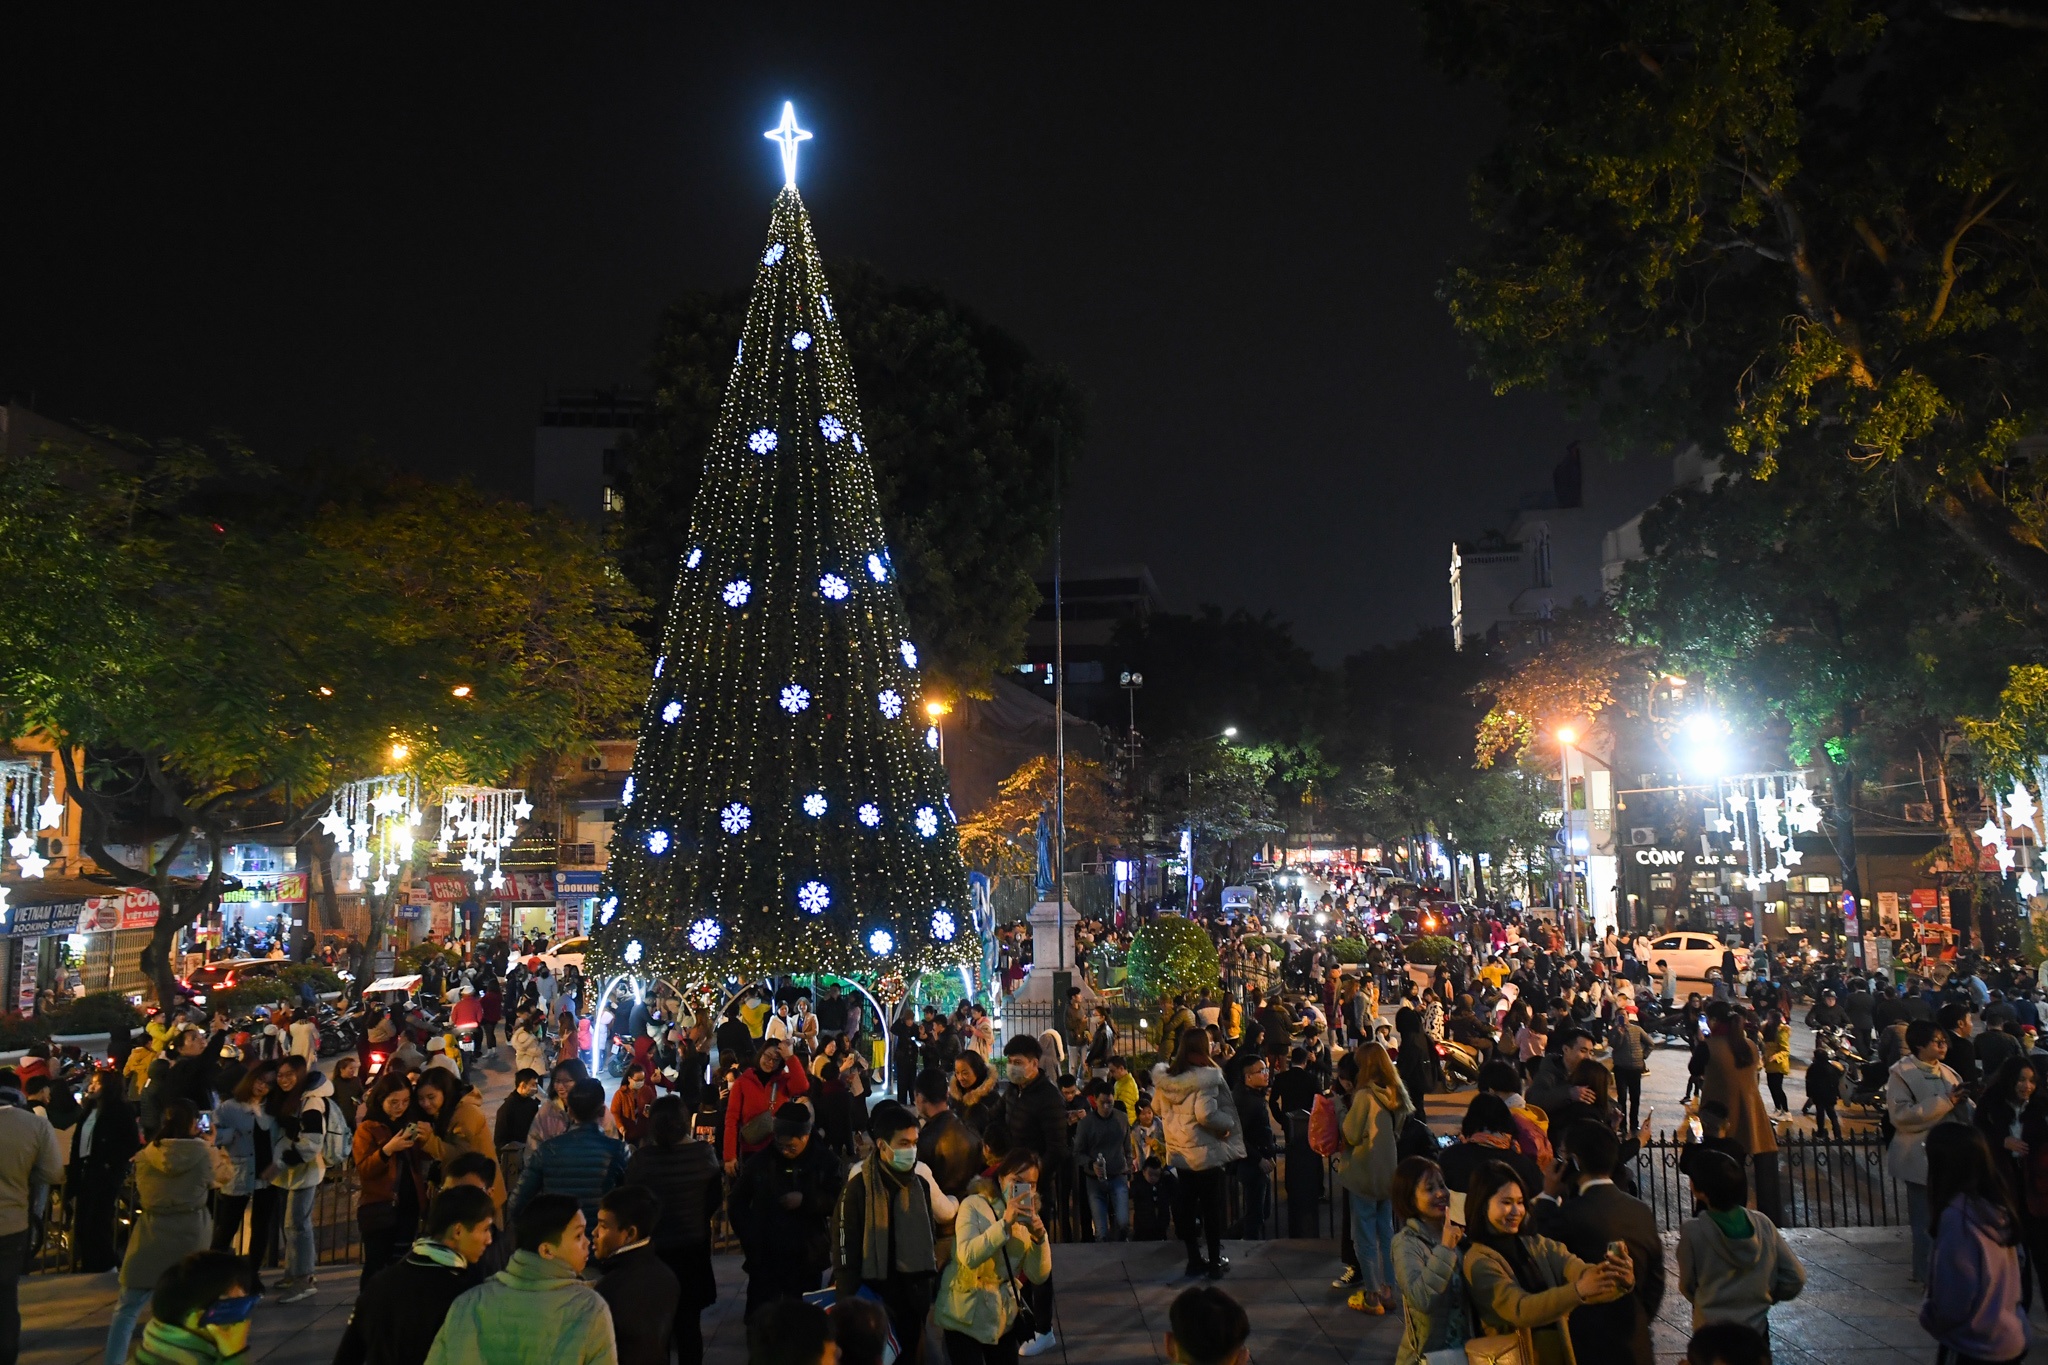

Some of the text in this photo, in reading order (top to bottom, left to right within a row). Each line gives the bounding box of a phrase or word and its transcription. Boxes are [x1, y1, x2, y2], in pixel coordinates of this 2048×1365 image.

[557, 884, 600, 893] BOOKING
[14, 905, 52, 922] VIETNAM
[1764, 902, 1777, 914] 27
[13, 922, 50, 933] BOOKING
[52, 919, 77, 929] OFFICE
